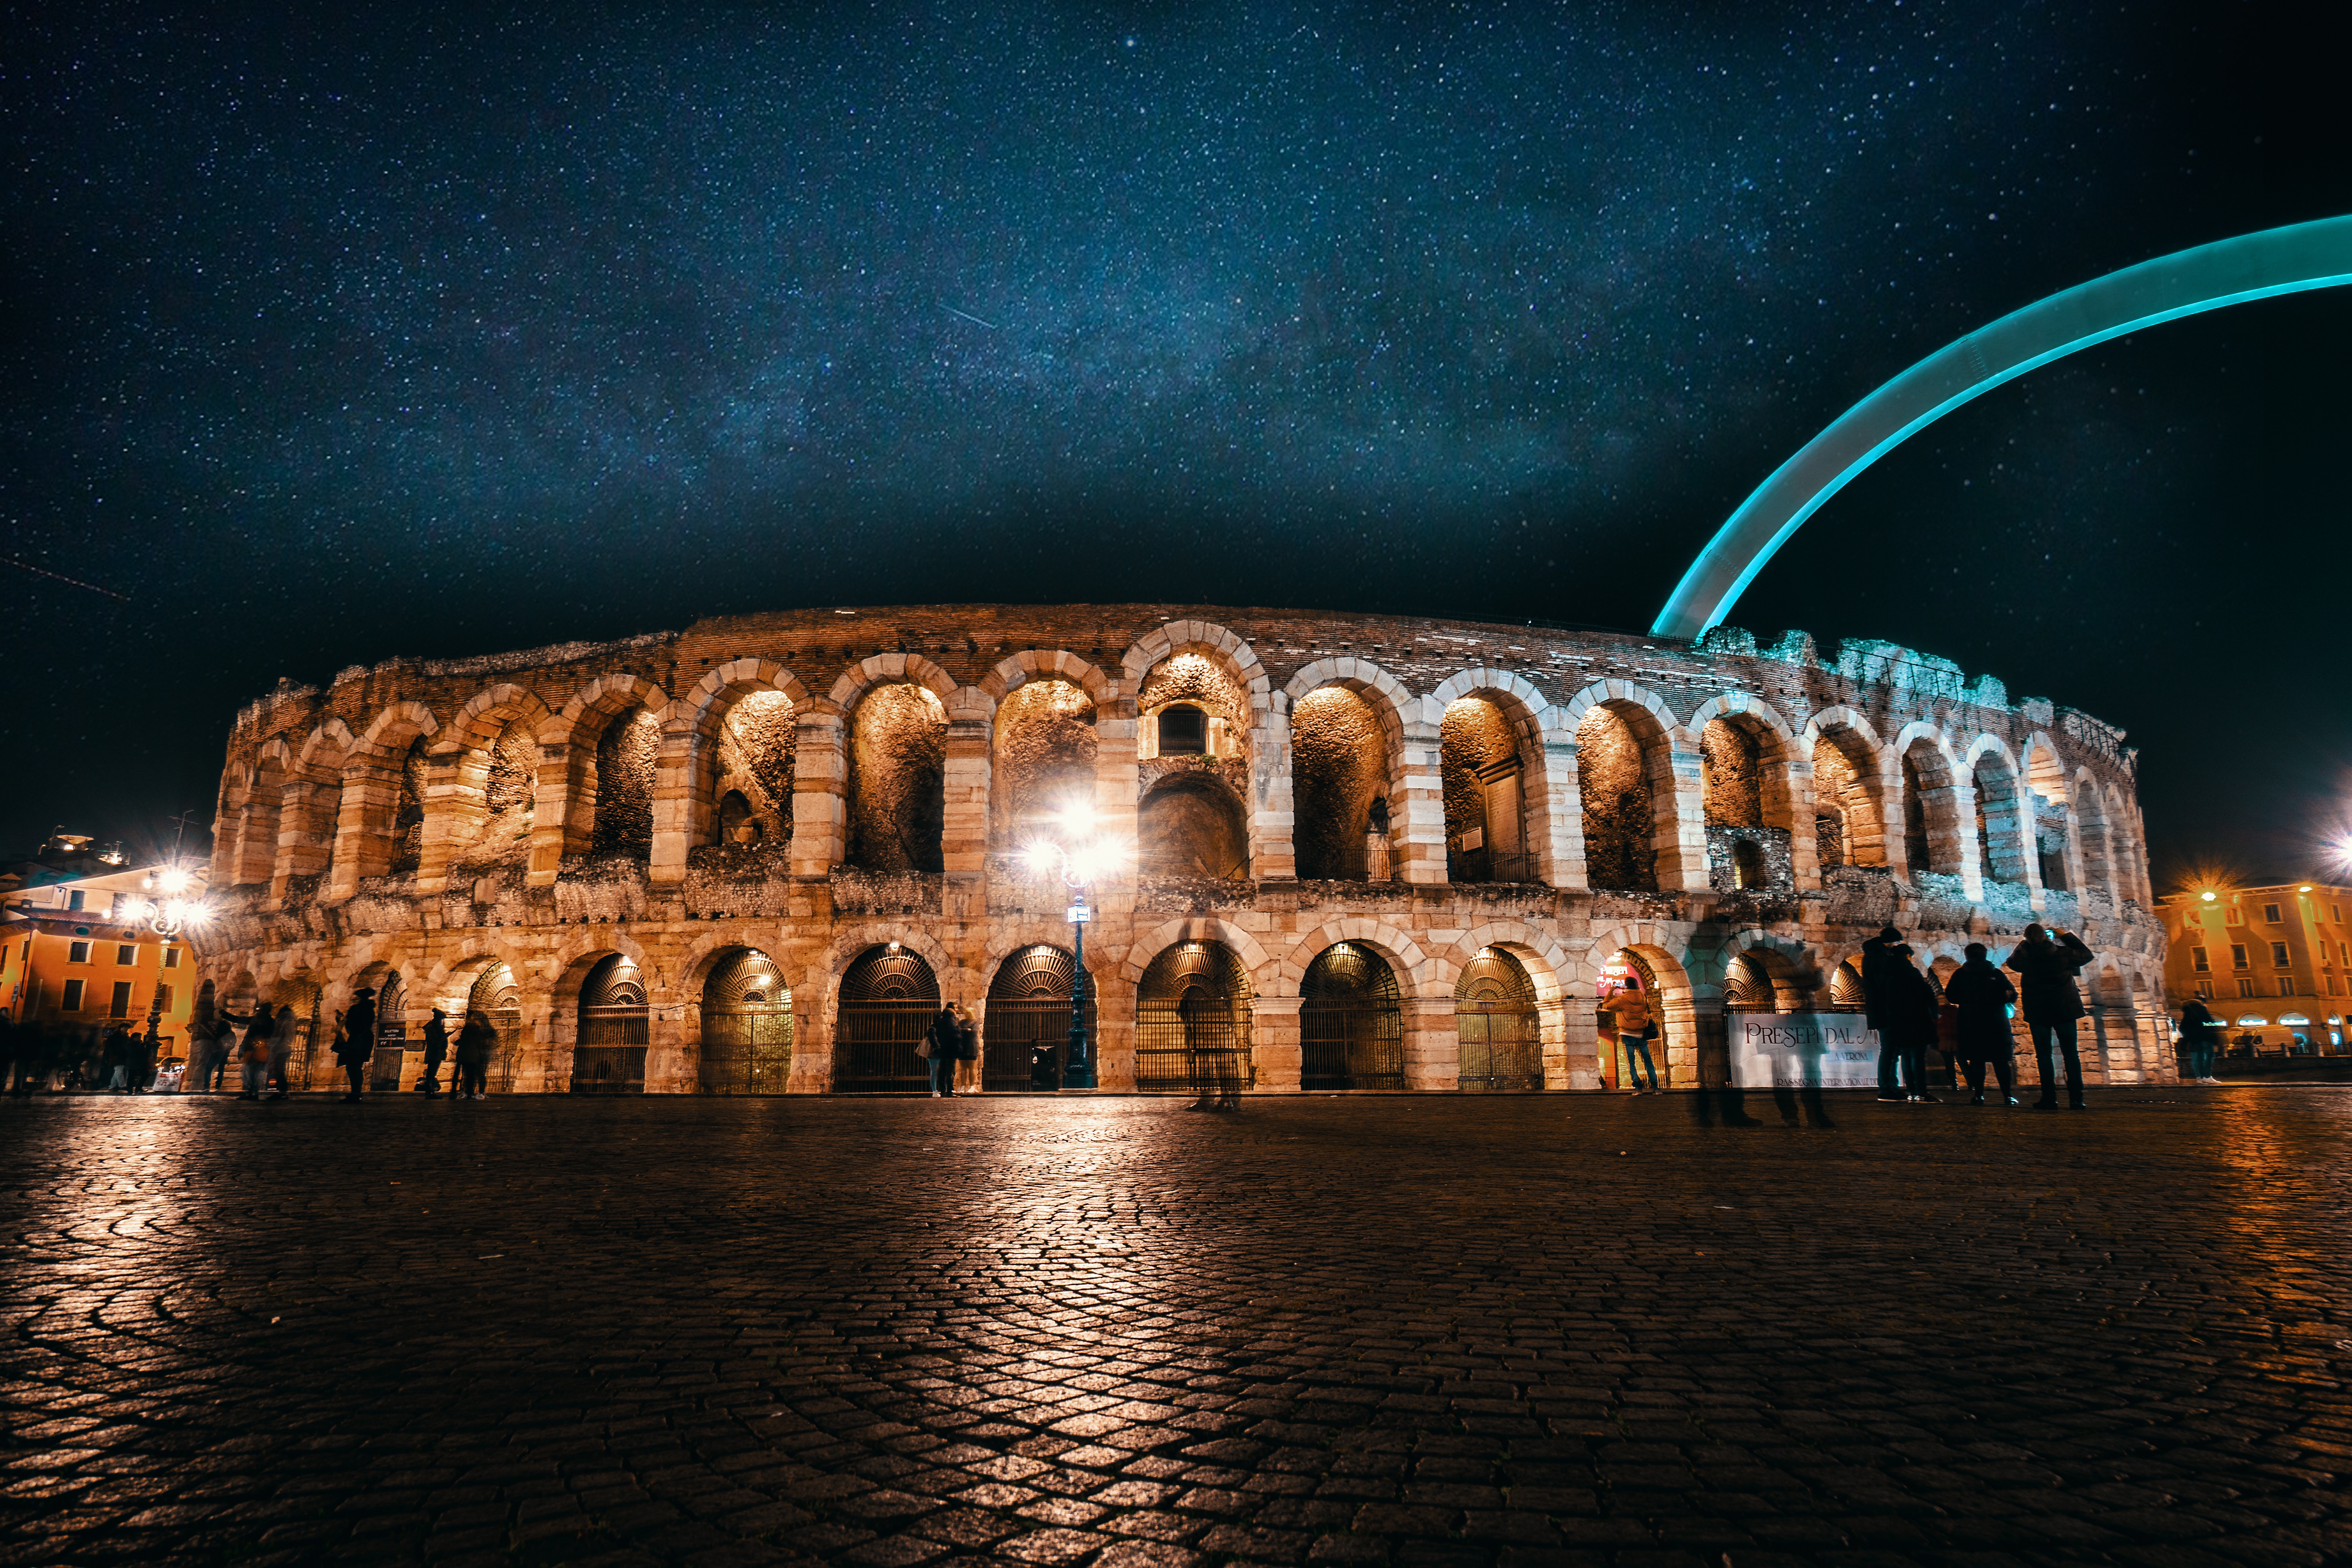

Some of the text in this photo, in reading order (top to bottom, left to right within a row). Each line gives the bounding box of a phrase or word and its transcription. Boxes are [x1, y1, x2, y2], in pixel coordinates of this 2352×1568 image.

[1744, 1023, 1820, 1048] PRESEPI
[1825, 1027, 1854, 1044] DAL
[1834, 1052, 1869, 1061] A VERONA
[1777, 1078, 1818, 1087] RASSEGNA
